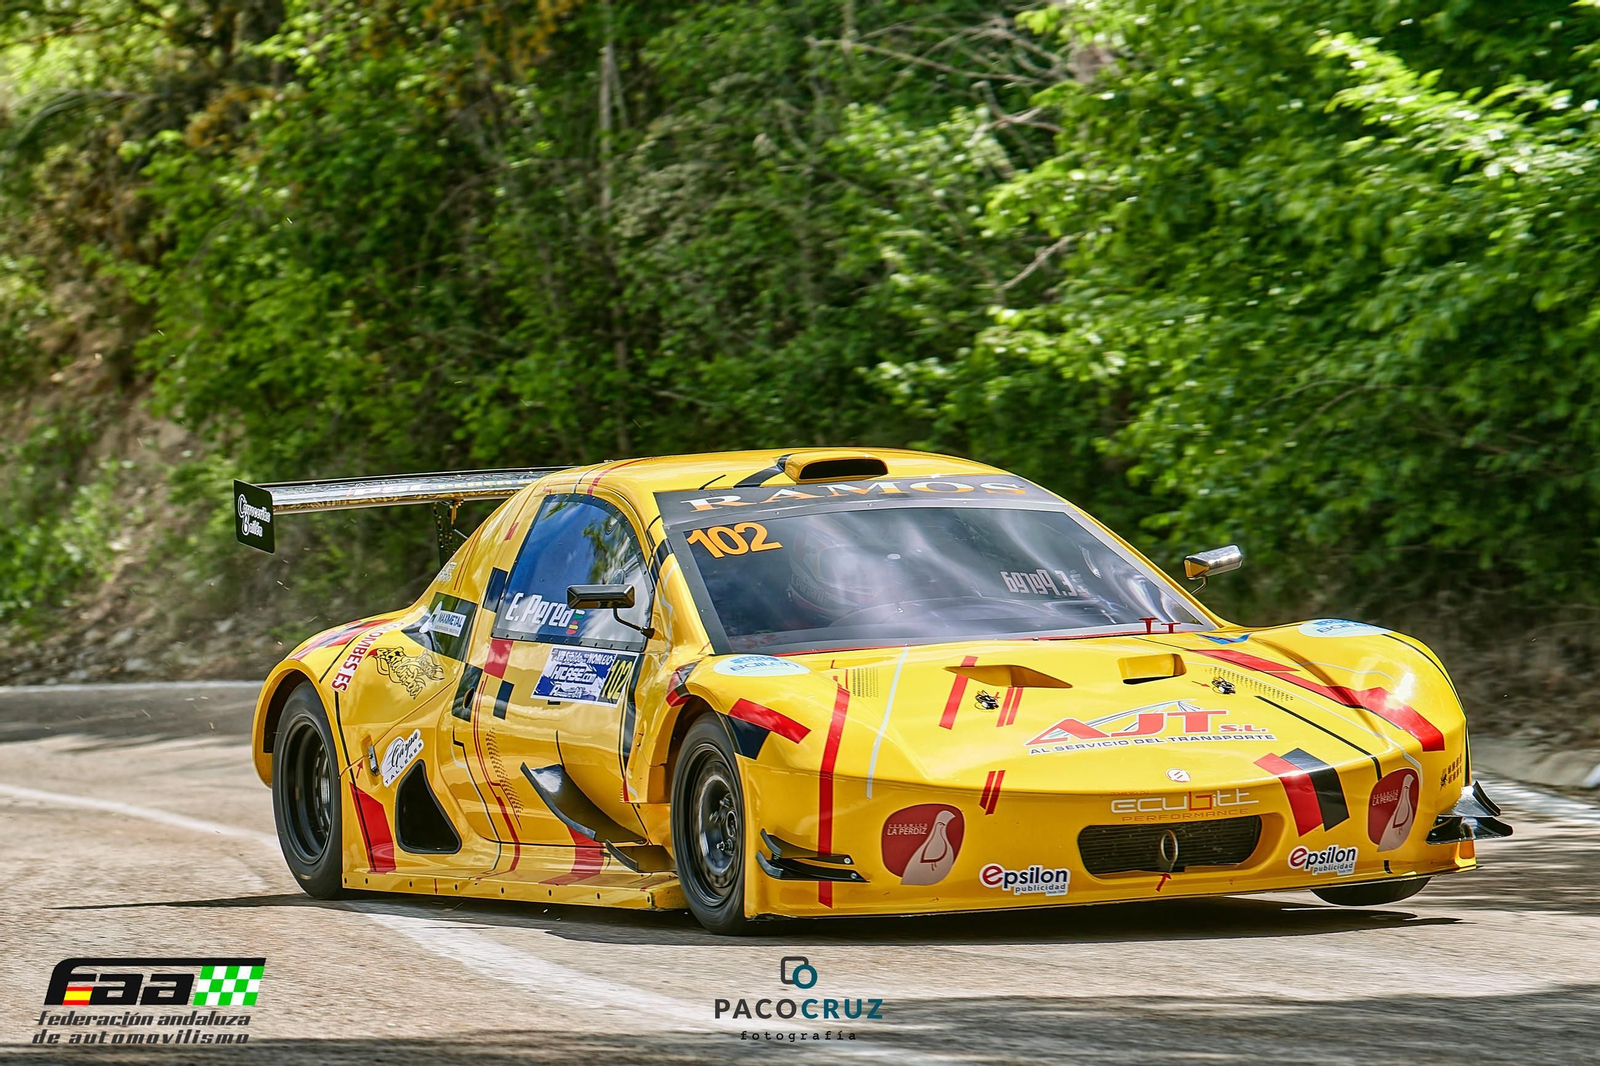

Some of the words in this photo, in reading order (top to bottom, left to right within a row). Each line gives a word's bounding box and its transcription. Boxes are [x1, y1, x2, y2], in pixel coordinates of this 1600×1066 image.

[680, 480, 1028, 513] RAMOS
[686, 521, 783, 559] 102
[601, 659, 633, 700] 102
[1026, 710, 1228, 746] AJT
[1030, 747, 1054, 755] AL
[1054, 739, 1129, 753] SERVICIO
[1134, 736, 1165, 745] DEL
[1168, 733, 1276, 744] TRANSPORTE
[384, 742, 423, 785] TALLERES
[1122, 808, 1249, 822] PERFORMANCE
[887, 828, 898, 836] LA
[898, 827, 928, 836] PERDIZ
[1289, 846, 1356, 870] epsilon
[1313, 862, 1354, 874] publicidad
[982, 865, 1068, 889] epsilon
[1015, 883, 1067, 894] publicidad
